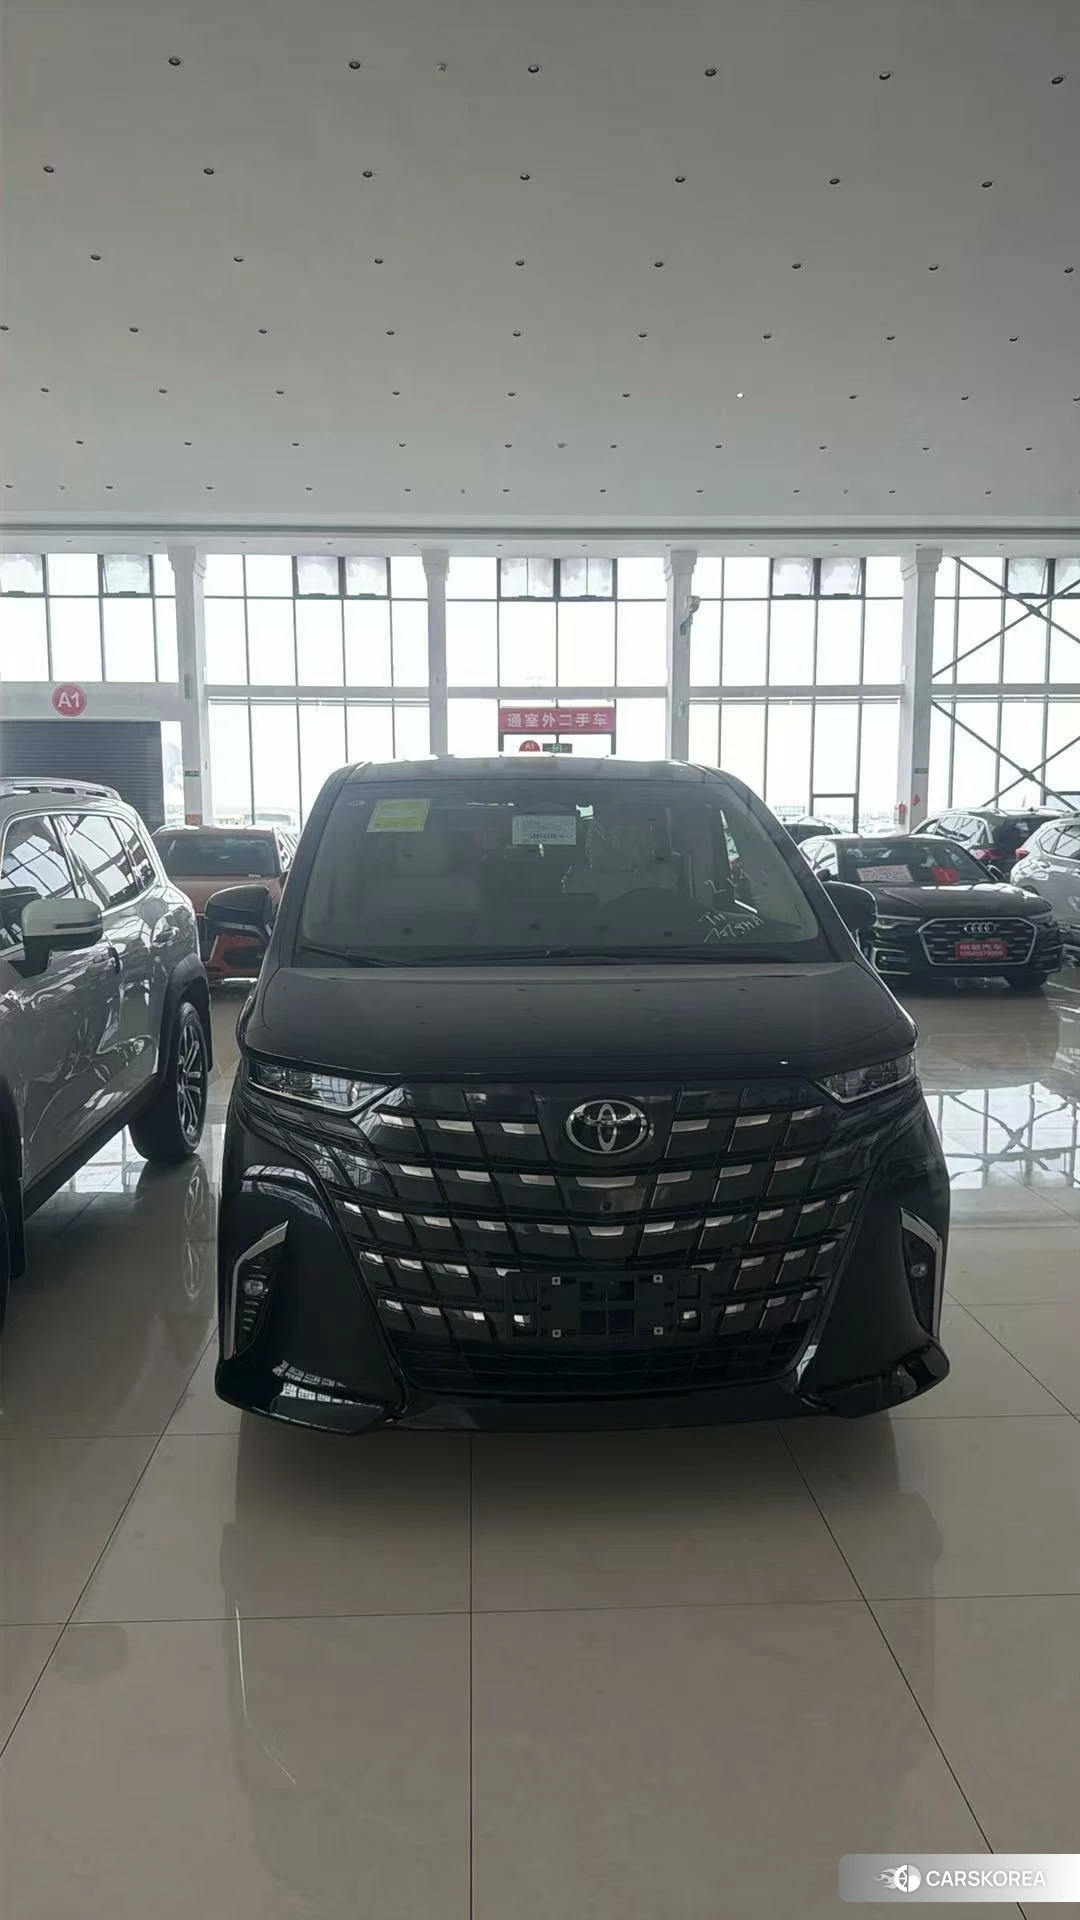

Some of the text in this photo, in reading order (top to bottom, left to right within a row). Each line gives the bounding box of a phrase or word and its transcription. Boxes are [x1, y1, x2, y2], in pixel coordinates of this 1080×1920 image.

[58, 691, 80, 708] A1
[507, 712, 608, 728] 通室外二手车
